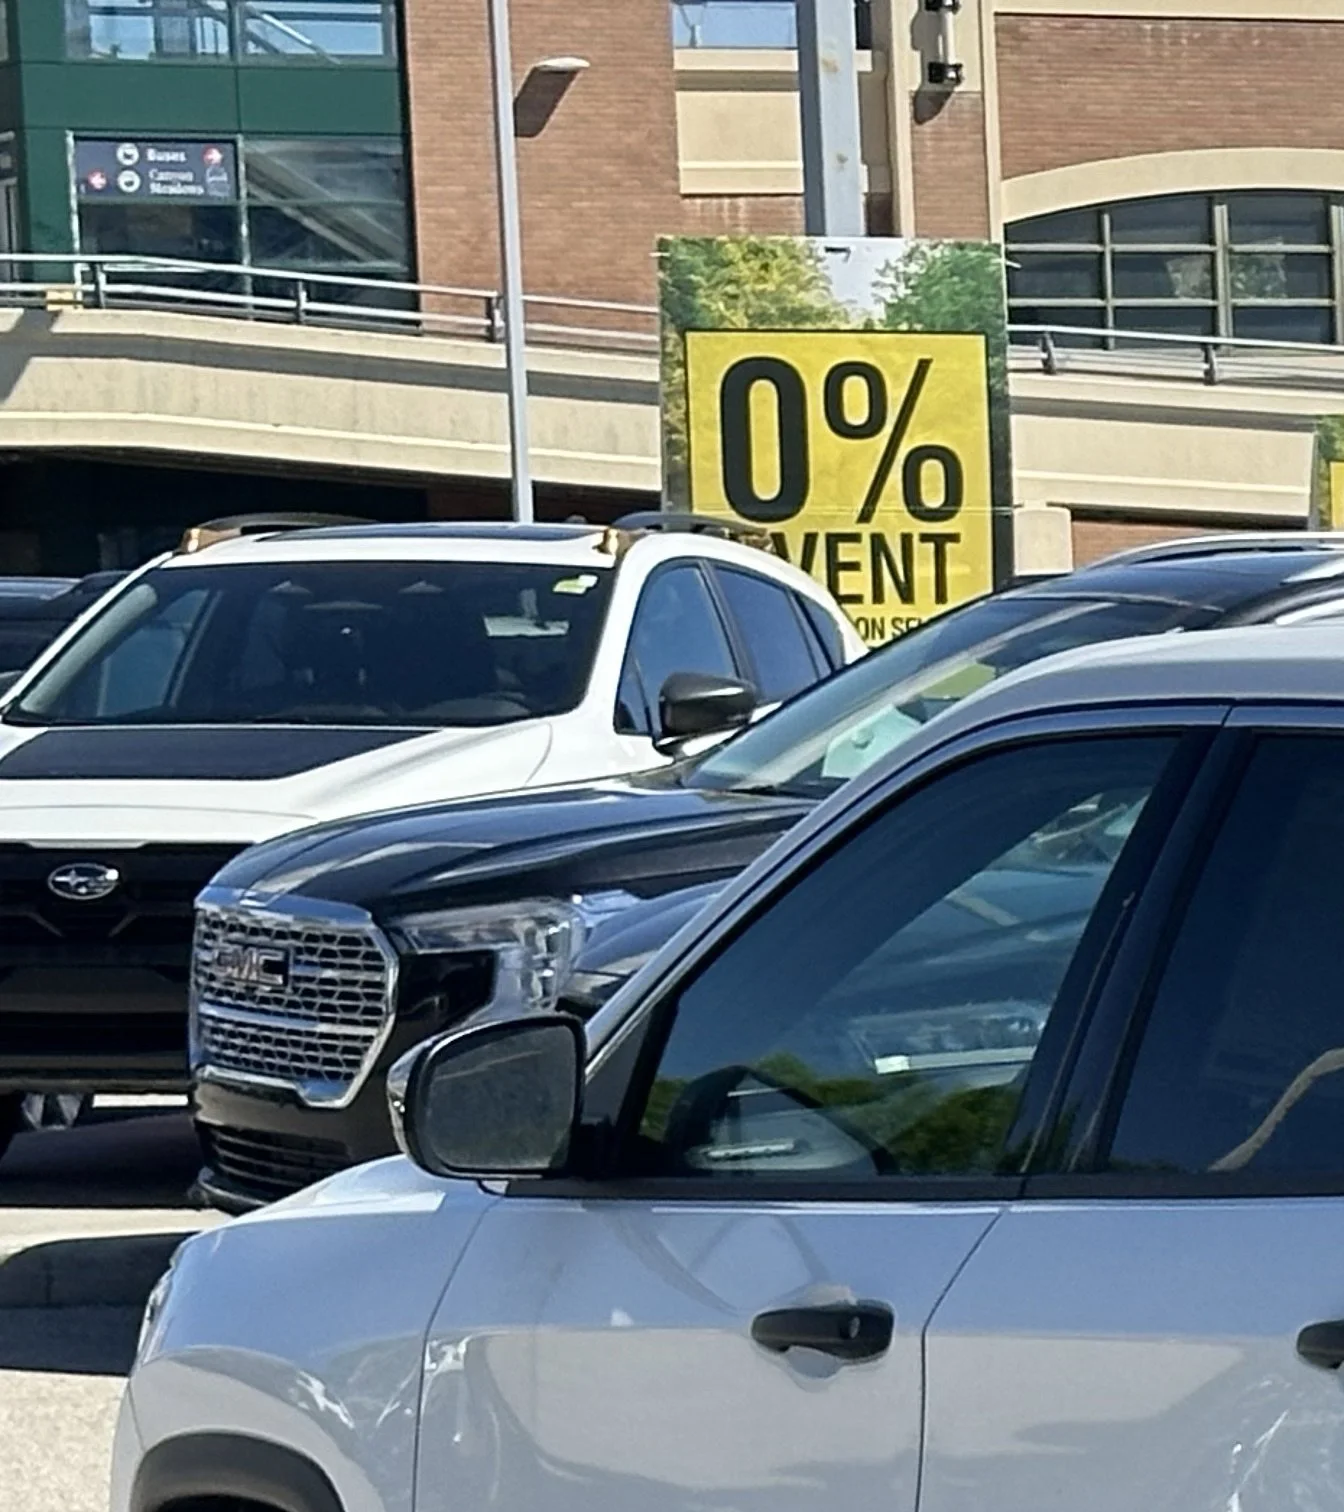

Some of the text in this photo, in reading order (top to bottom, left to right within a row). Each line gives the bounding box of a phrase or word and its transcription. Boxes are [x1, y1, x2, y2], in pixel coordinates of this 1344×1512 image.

[147, 148, 187, 162] Buses
[719, 354, 965, 525] 0%
[769, 531, 962, 605] VENT
[211, 944, 284, 986] GMC
